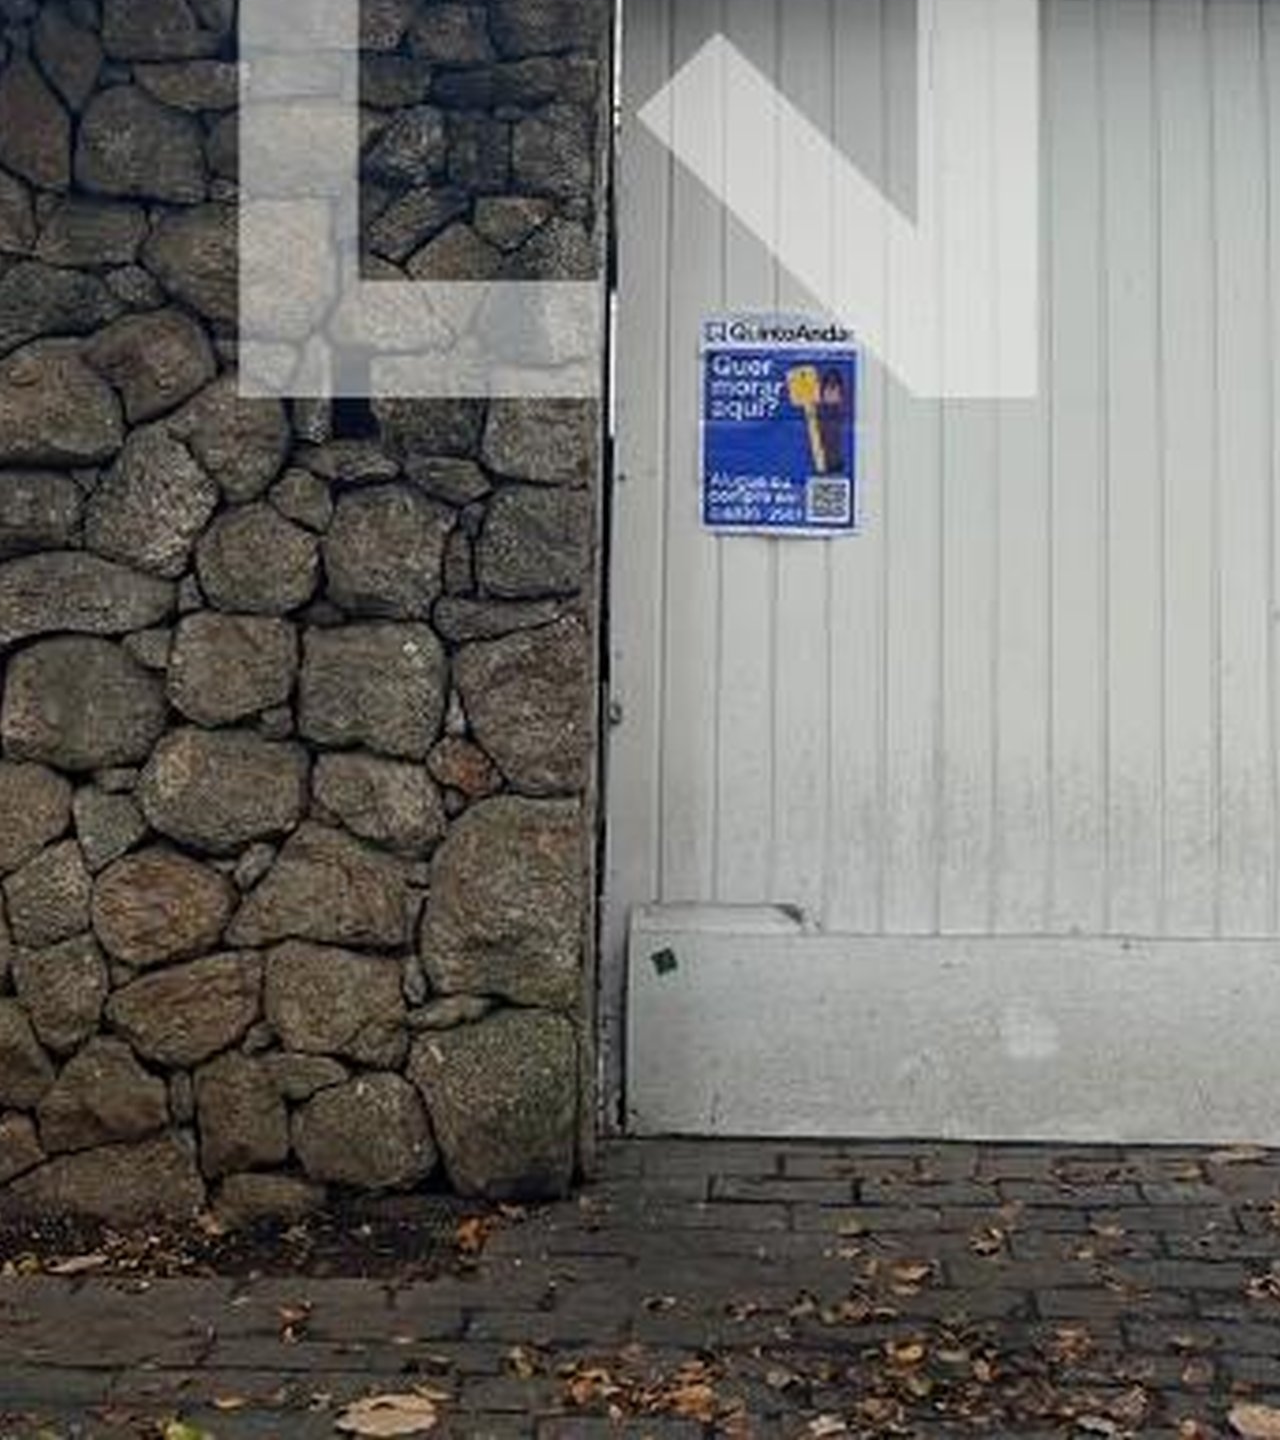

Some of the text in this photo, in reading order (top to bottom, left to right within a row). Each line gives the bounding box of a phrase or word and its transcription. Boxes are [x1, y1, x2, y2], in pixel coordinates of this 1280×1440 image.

[713, 356, 773, 376] Quer
[711, 380, 784, 397] morar
[711, 398, 780, 421] aqui?
